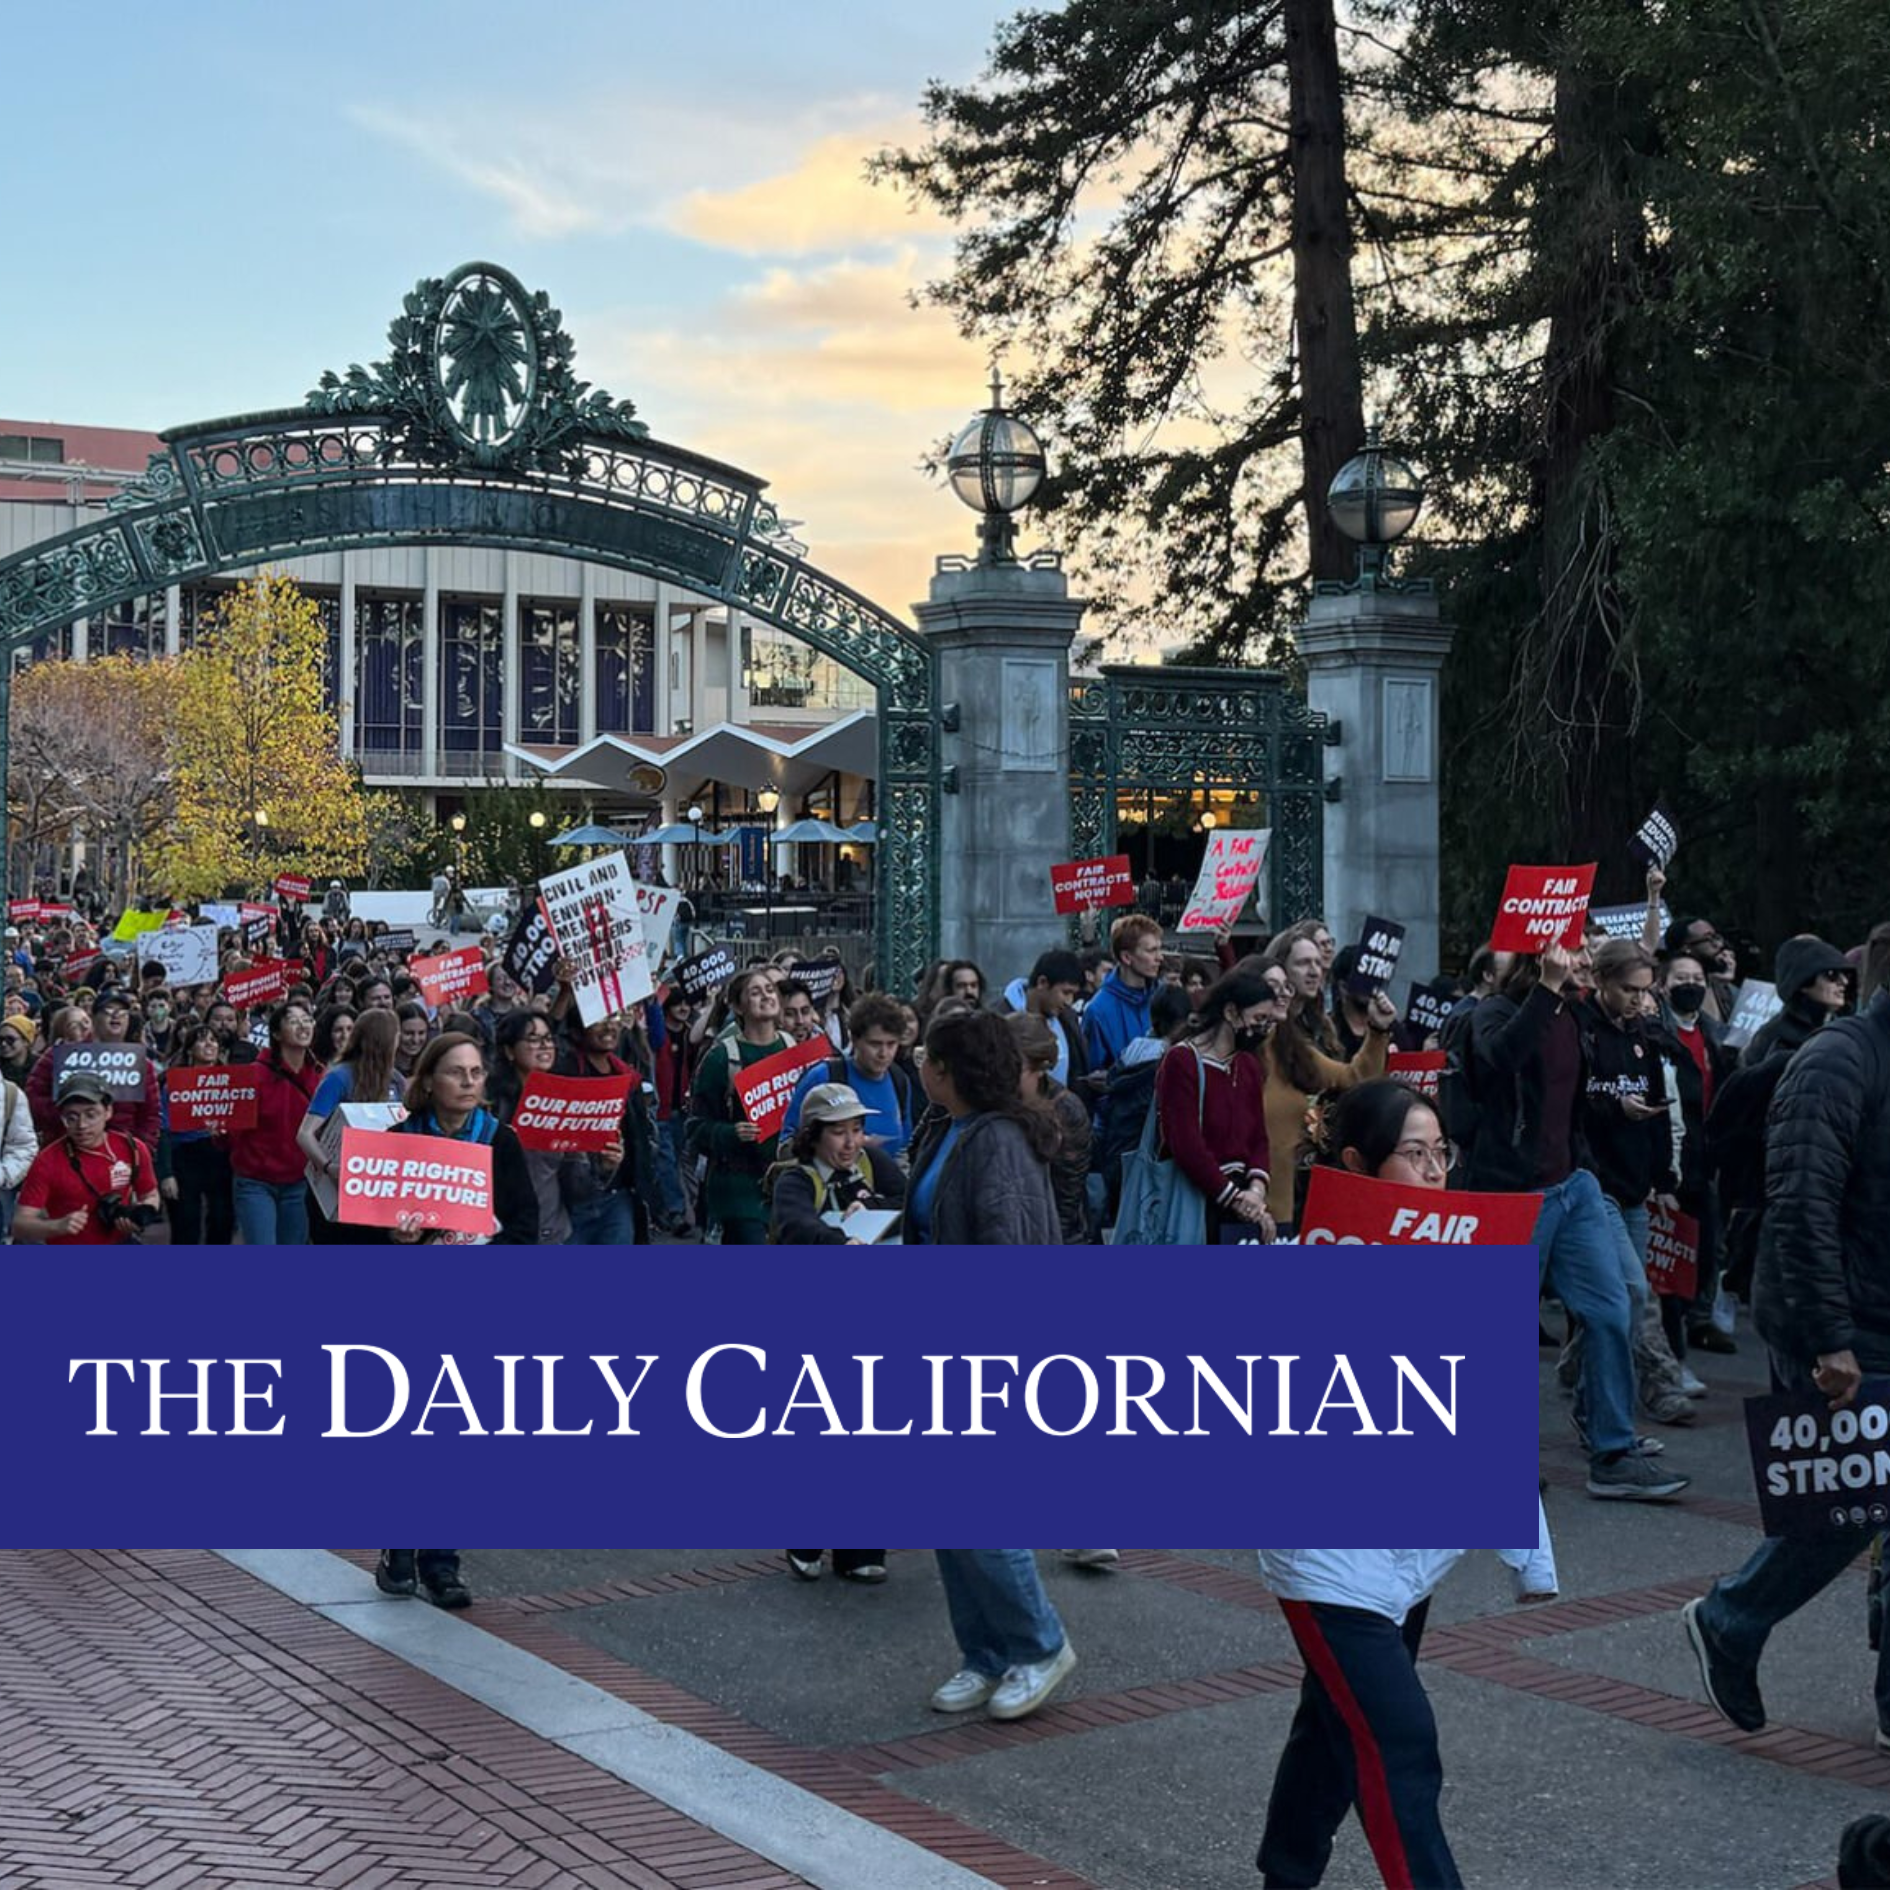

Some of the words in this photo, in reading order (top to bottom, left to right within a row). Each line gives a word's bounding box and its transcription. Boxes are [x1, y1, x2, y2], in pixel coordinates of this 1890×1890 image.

[1055, 871, 1130, 893] CONTRACTS
[1077, 864, 1105, 878] FAIR
[544, 877, 585, 903] CIVIL
[588, 862, 618, 886] AND
[1074, 886, 1110, 901] NOW!
[1542, 878, 1578, 895] FAIR
[511, 914, 548, 971] 40,00
[421, 961, 483, 987] CONTRACTS
[440, 956, 463, 971] FAIR
[520, 937, 556, 990] STRO
[440, 976, 470, 993] NOW!
[684, 961, 735, 995] STRONG
[1416, 993, 1453, 1016] 40,0
[64, 1051, 137, 1069] 40,000
[58, 1069, 141, 1086] SONG
[197, 1073, 230, 1087] FAIR
[169, 1087, 256, 1103] CONTRACTS
[744, 1080, 772, 1106] OUR
[191, 1102, 234, 1117] NOW!
[525, 1094, 567, 1112] OUR
[566, 1098, 624, 1115] RIGHTS
[750, 1097, 777, 1121] OUR
[517, 1112, 560, 1131] OUR
[347, 1156, 399, 1176] OUR
[401, 1160, 487, 1188] RIGHTS
[345, 1178, 397, 1198] OUR
[400, 1181, 489, 1209] FUTURE
[1389, 1207, 1479, 1245] FAIR
[1769, 1404, 1890, 1453] 40,00
[1766, 1449, 1890, 1497] STRON
